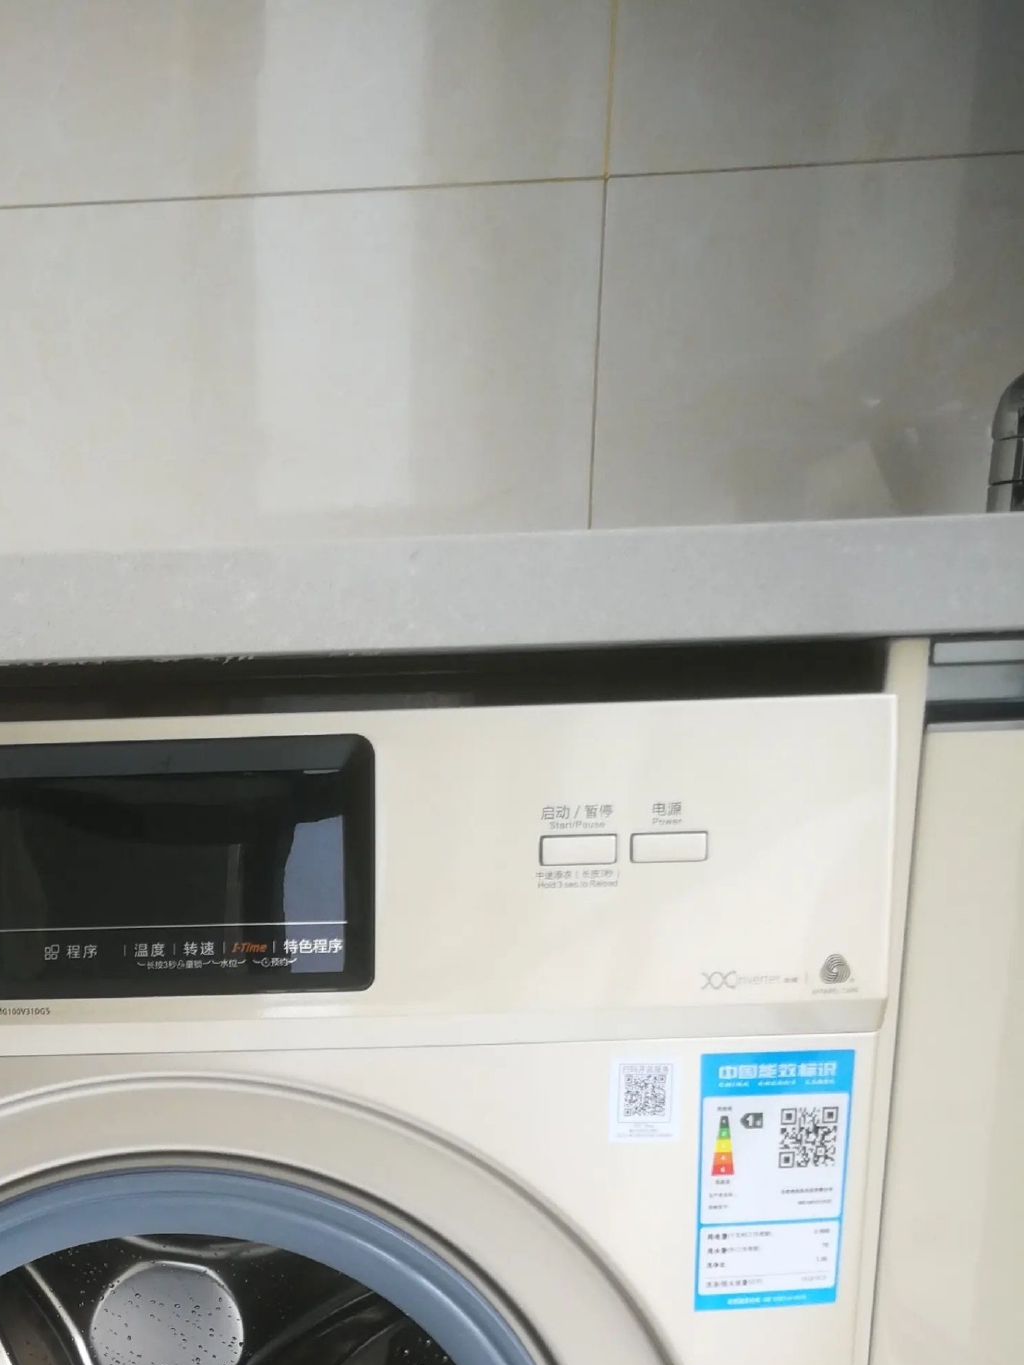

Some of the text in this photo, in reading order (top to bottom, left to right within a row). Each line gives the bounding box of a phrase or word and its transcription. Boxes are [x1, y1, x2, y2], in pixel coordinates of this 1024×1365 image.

[541, 806, 570, 820] 启动
[584, 804, 614, 818] 暂停
[652, 801, 682, 816] 电源
[549, 821, 606, 829] Start/Pause
[652, 817, 682, 826] Power
[66, 944, 98, 959] 程序
[134, 943, 165, 958] 温度
[183, 941, 215, 956] 转速
[283, 938, 344, 954] 特色程序
[718, 1062, 837, 1080] 中国能效标识
